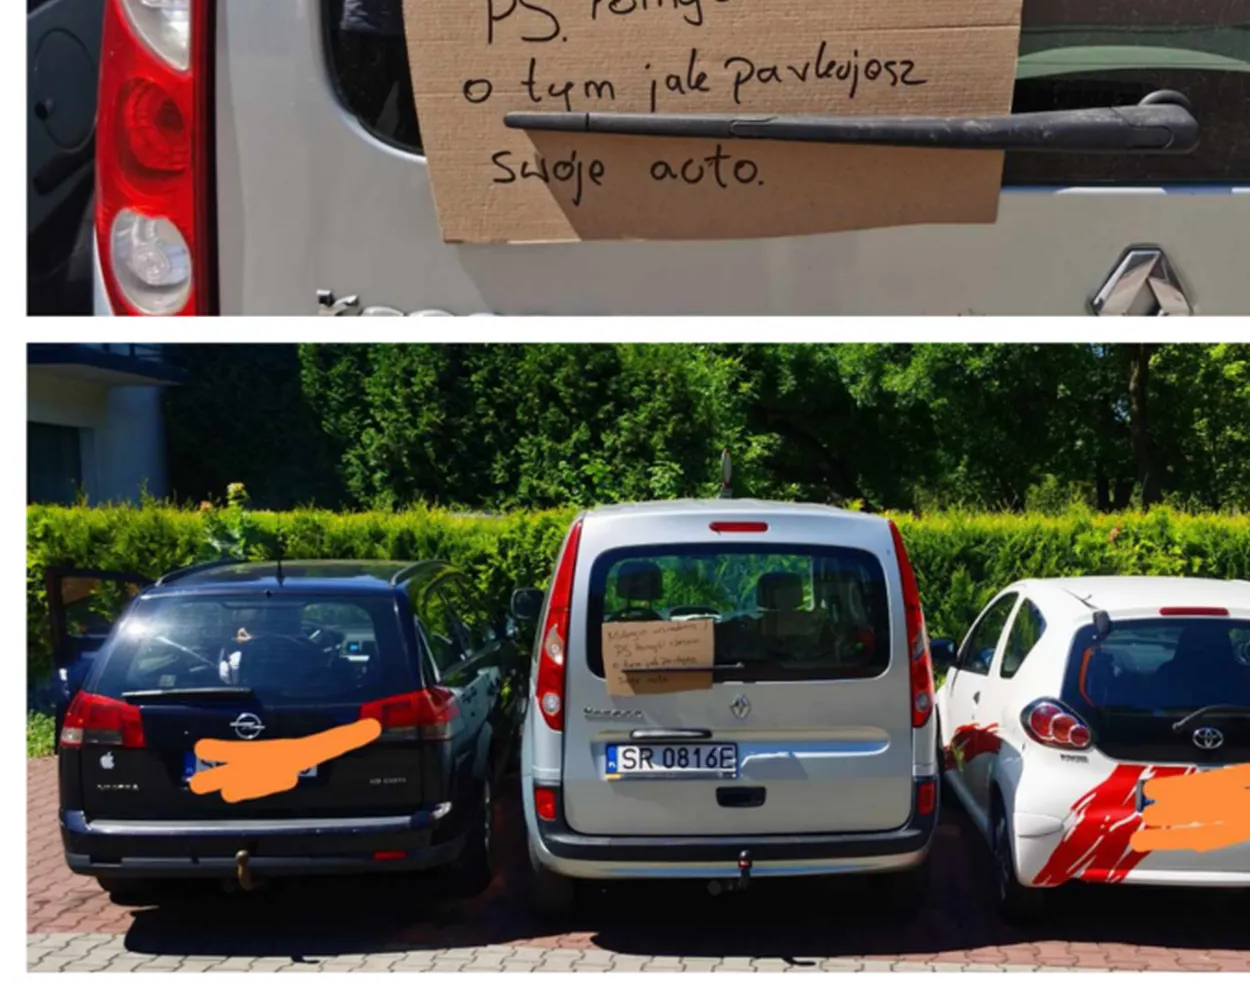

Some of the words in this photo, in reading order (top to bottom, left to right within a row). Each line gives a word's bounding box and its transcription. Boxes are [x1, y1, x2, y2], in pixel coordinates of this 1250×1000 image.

[463, 78, 493, 103] o
[521, 57, 616, 112] tym
[645, 48, 710, 113] jak
[491, 151, 605, 207] swoje
[650, 144, 765, 188] auto.
[622, 748, 653, 769] SR
[662, 747, 735, 769] 0816E
